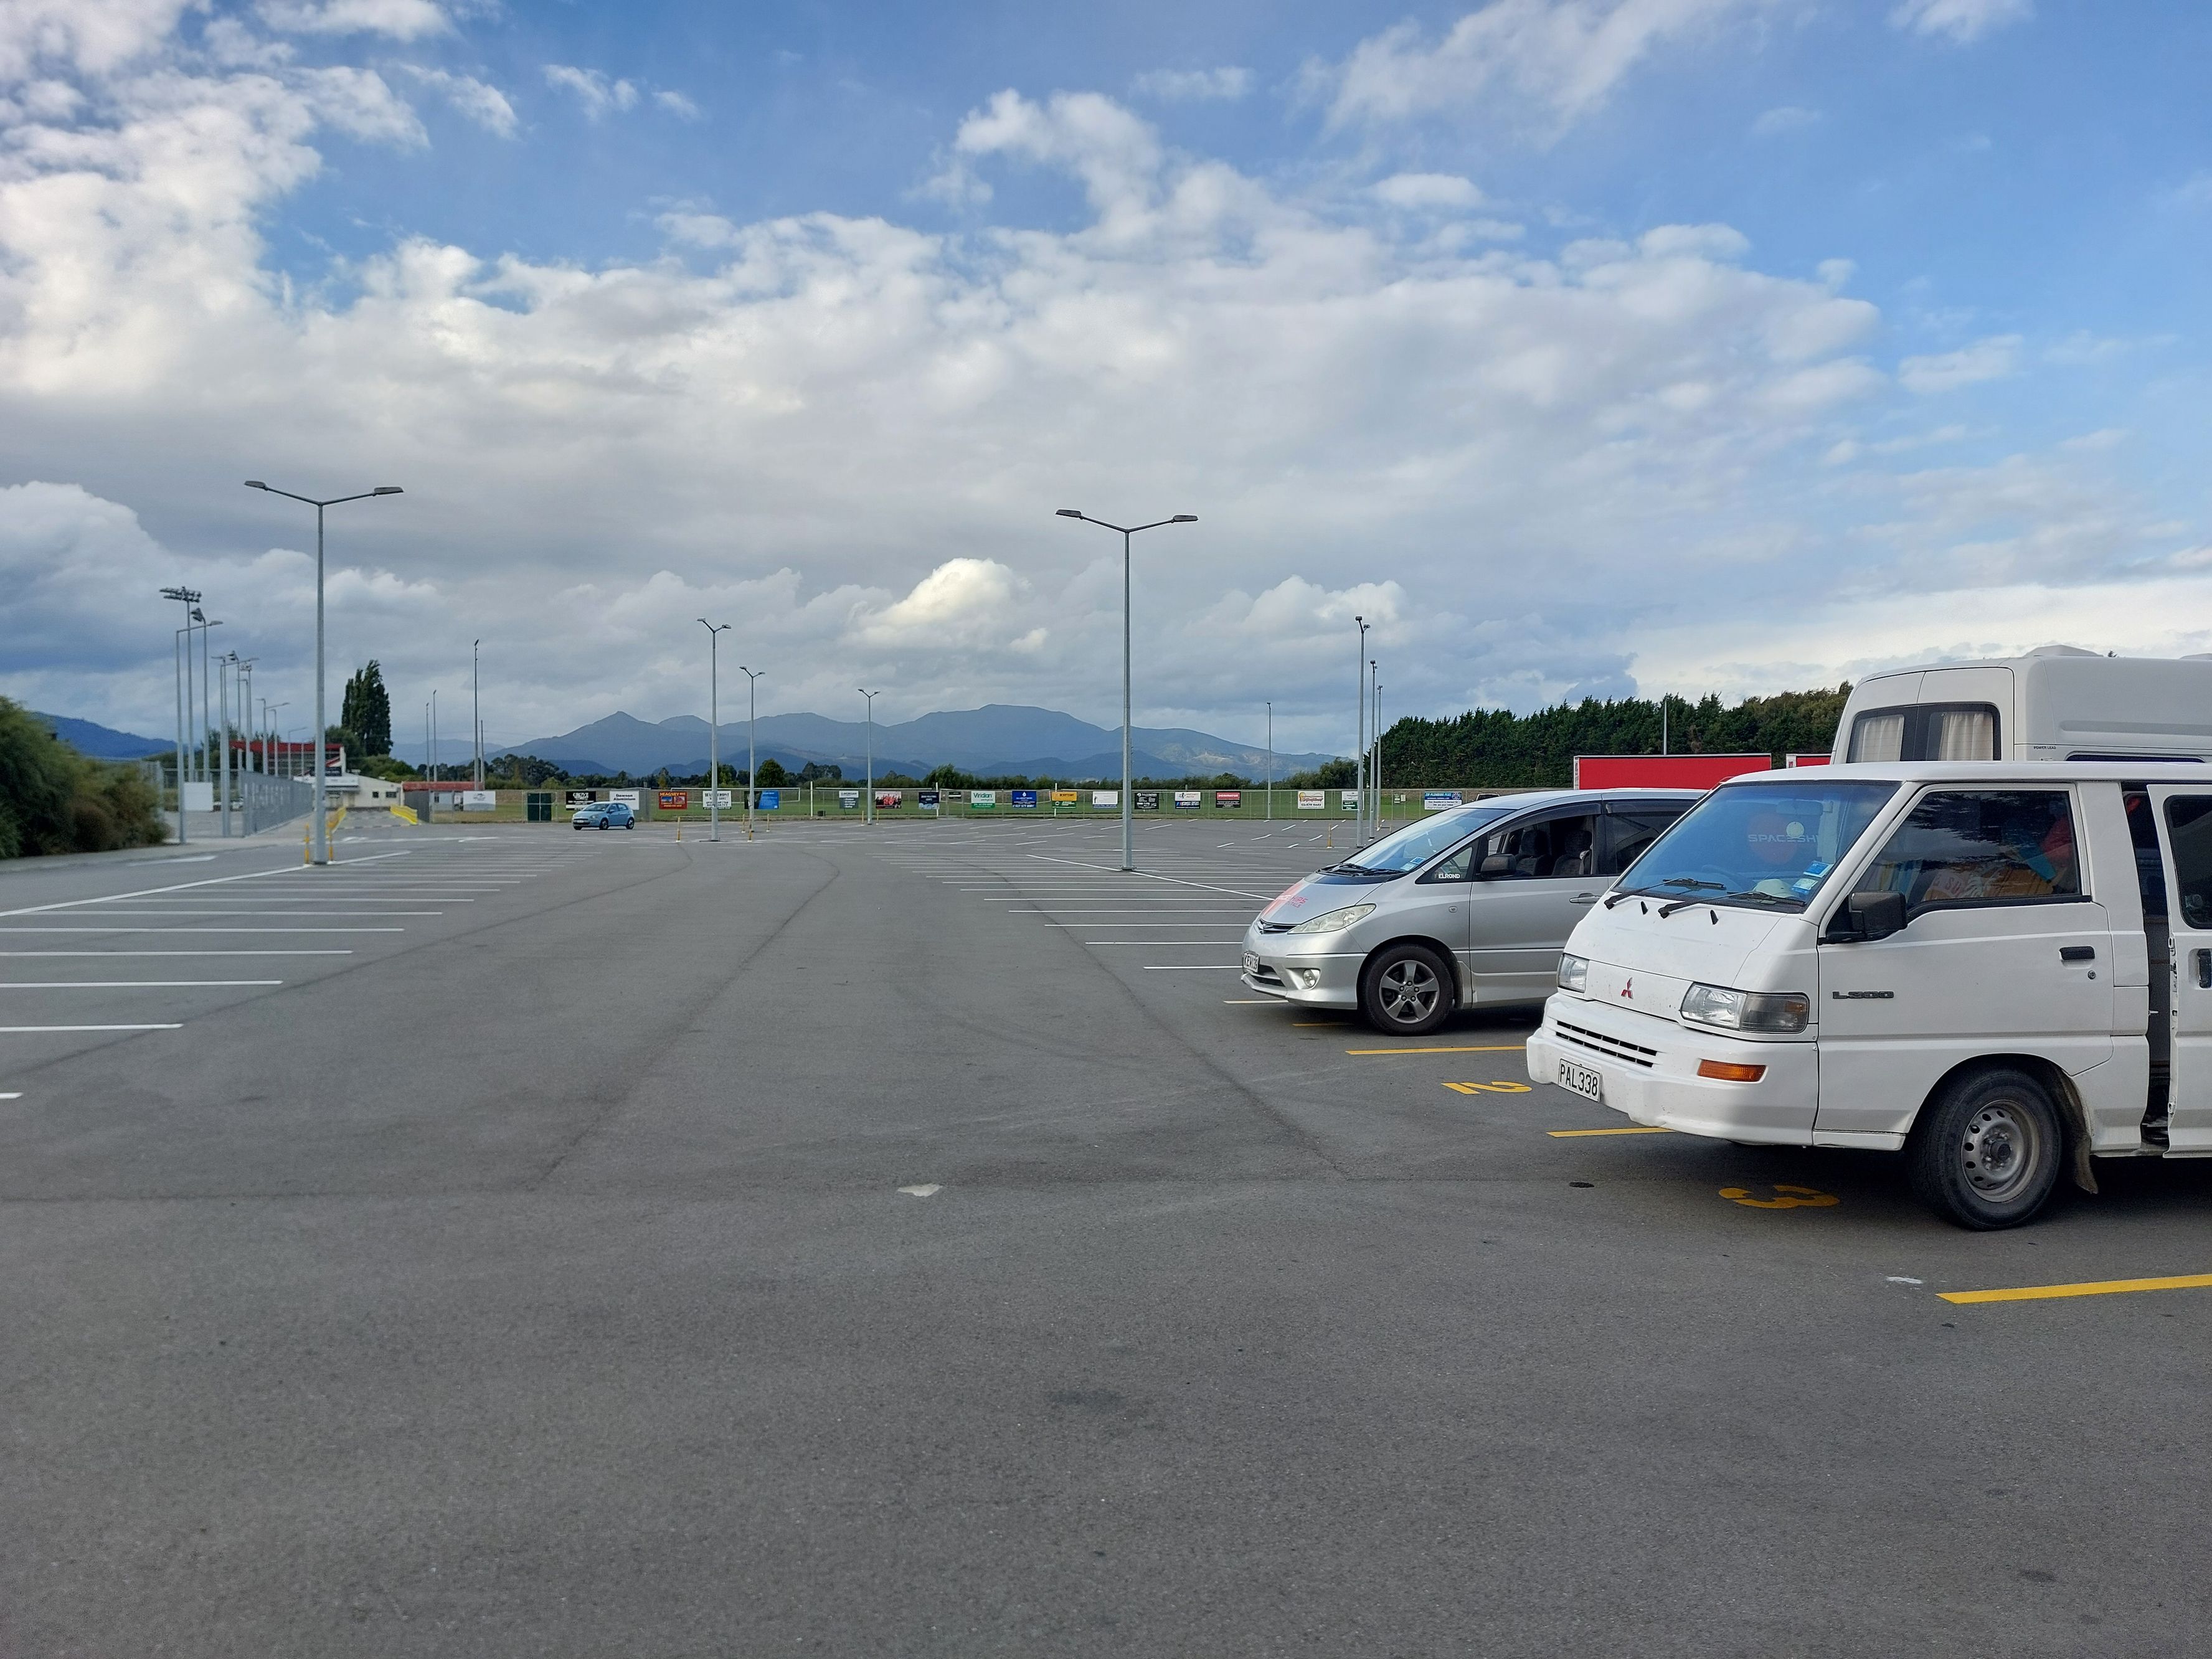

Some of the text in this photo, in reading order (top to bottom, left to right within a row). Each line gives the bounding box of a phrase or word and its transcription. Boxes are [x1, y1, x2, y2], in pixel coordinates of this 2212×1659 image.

[1832, 991, 1894, 999] L300
[1559, 1063, 1598, 1097] PAL338
[1718, 1184, 1840, 1209] 3
